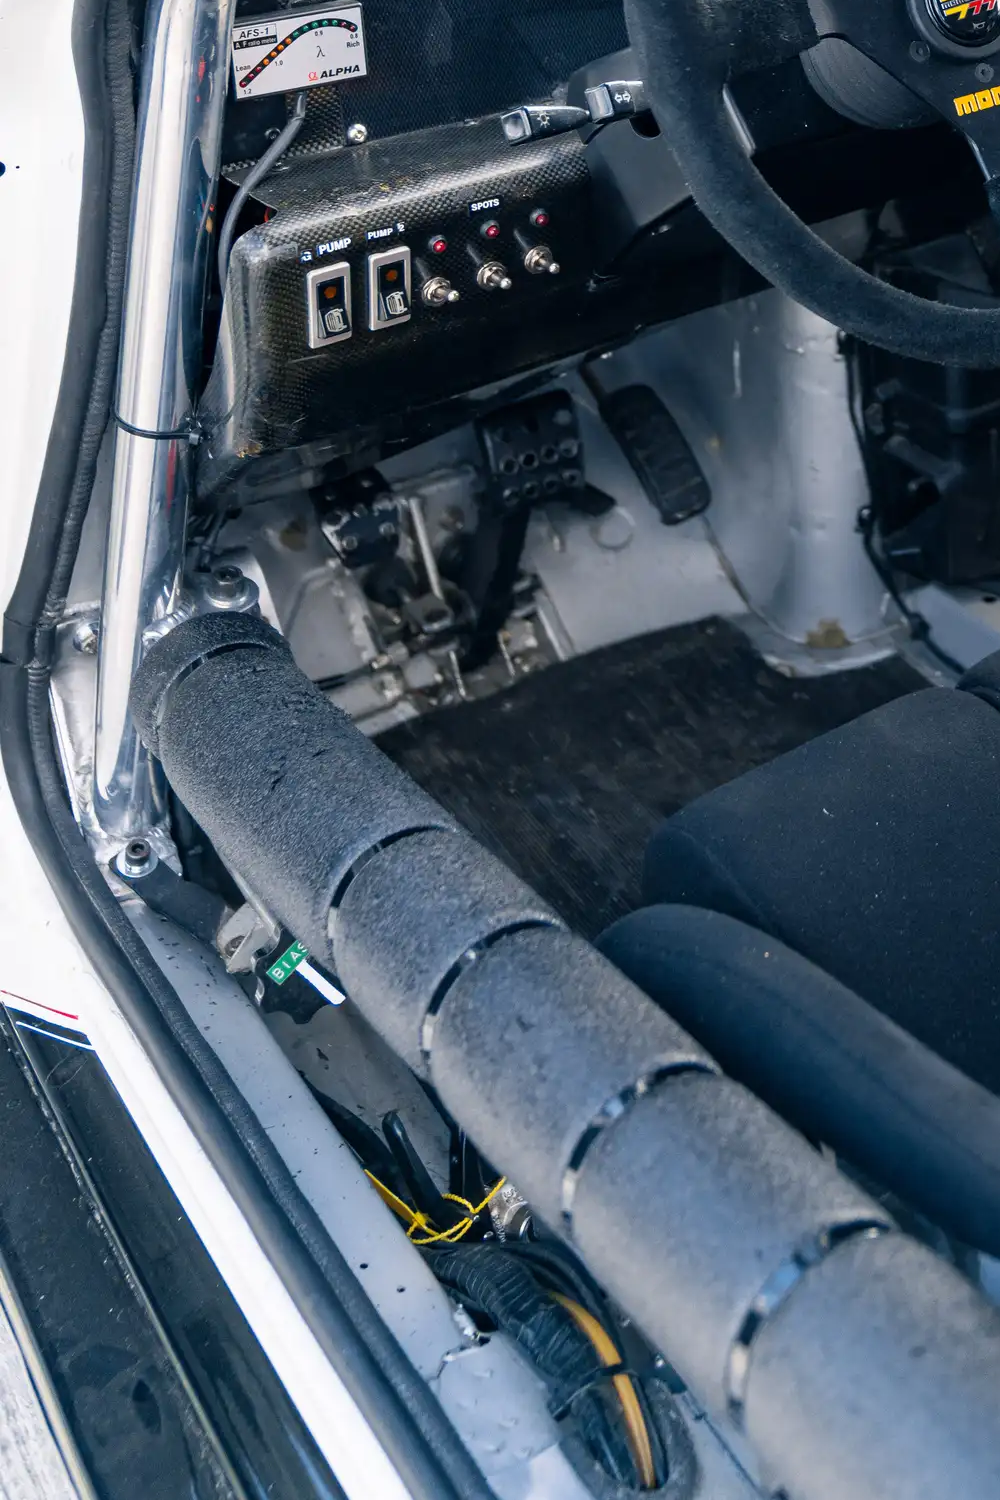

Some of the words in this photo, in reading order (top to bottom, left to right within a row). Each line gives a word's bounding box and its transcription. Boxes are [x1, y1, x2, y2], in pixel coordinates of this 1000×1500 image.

[239, 27, 269, 40] AFS-1
[235, 64, 251, 72] Lean
[320, 65, 360, 79] ALPHA
[471, 199, 500, 212] SPOTS
[368, 228, 393, 239] PUMP
[318, 238, 351, 255] PUMP
